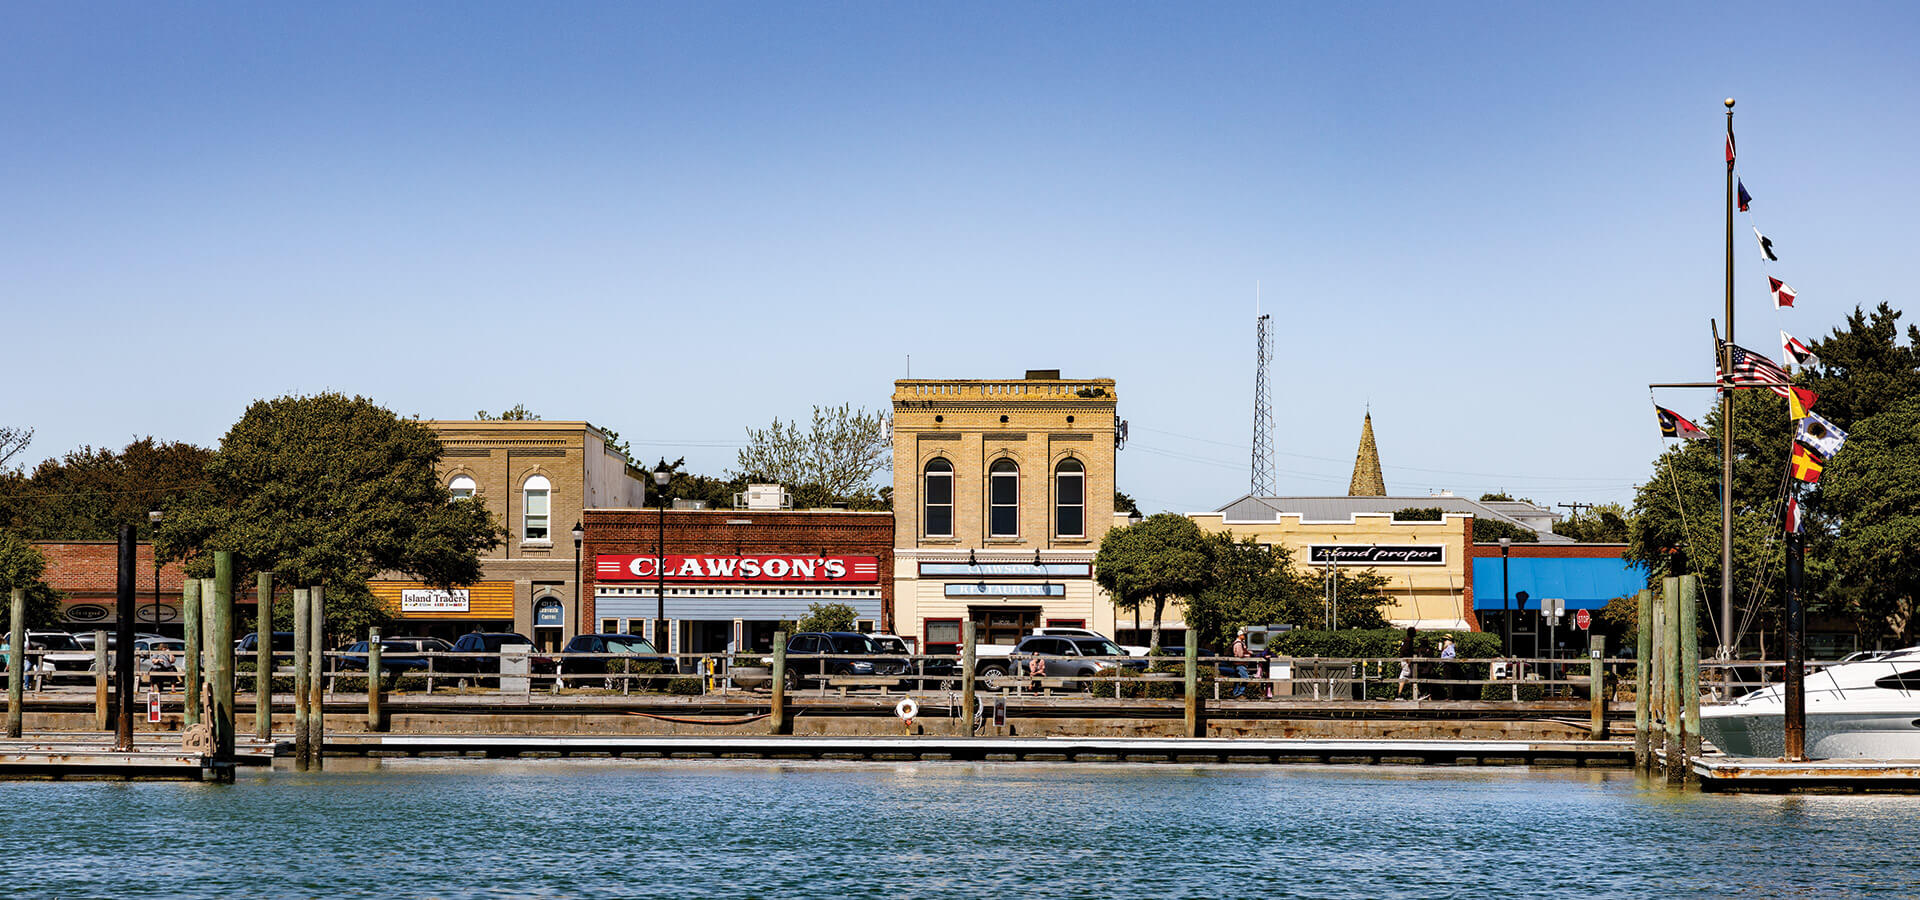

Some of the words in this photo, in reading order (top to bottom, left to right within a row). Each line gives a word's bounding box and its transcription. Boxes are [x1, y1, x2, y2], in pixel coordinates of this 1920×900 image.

[1373, 550, 1437, 561] proper
[629, 557, 846, 578] CLAWSON'S
[405, 594, 431, 602] Island
[433, 594, 466, 602] Traders
[1578, 615, 1590, 624] STOP
